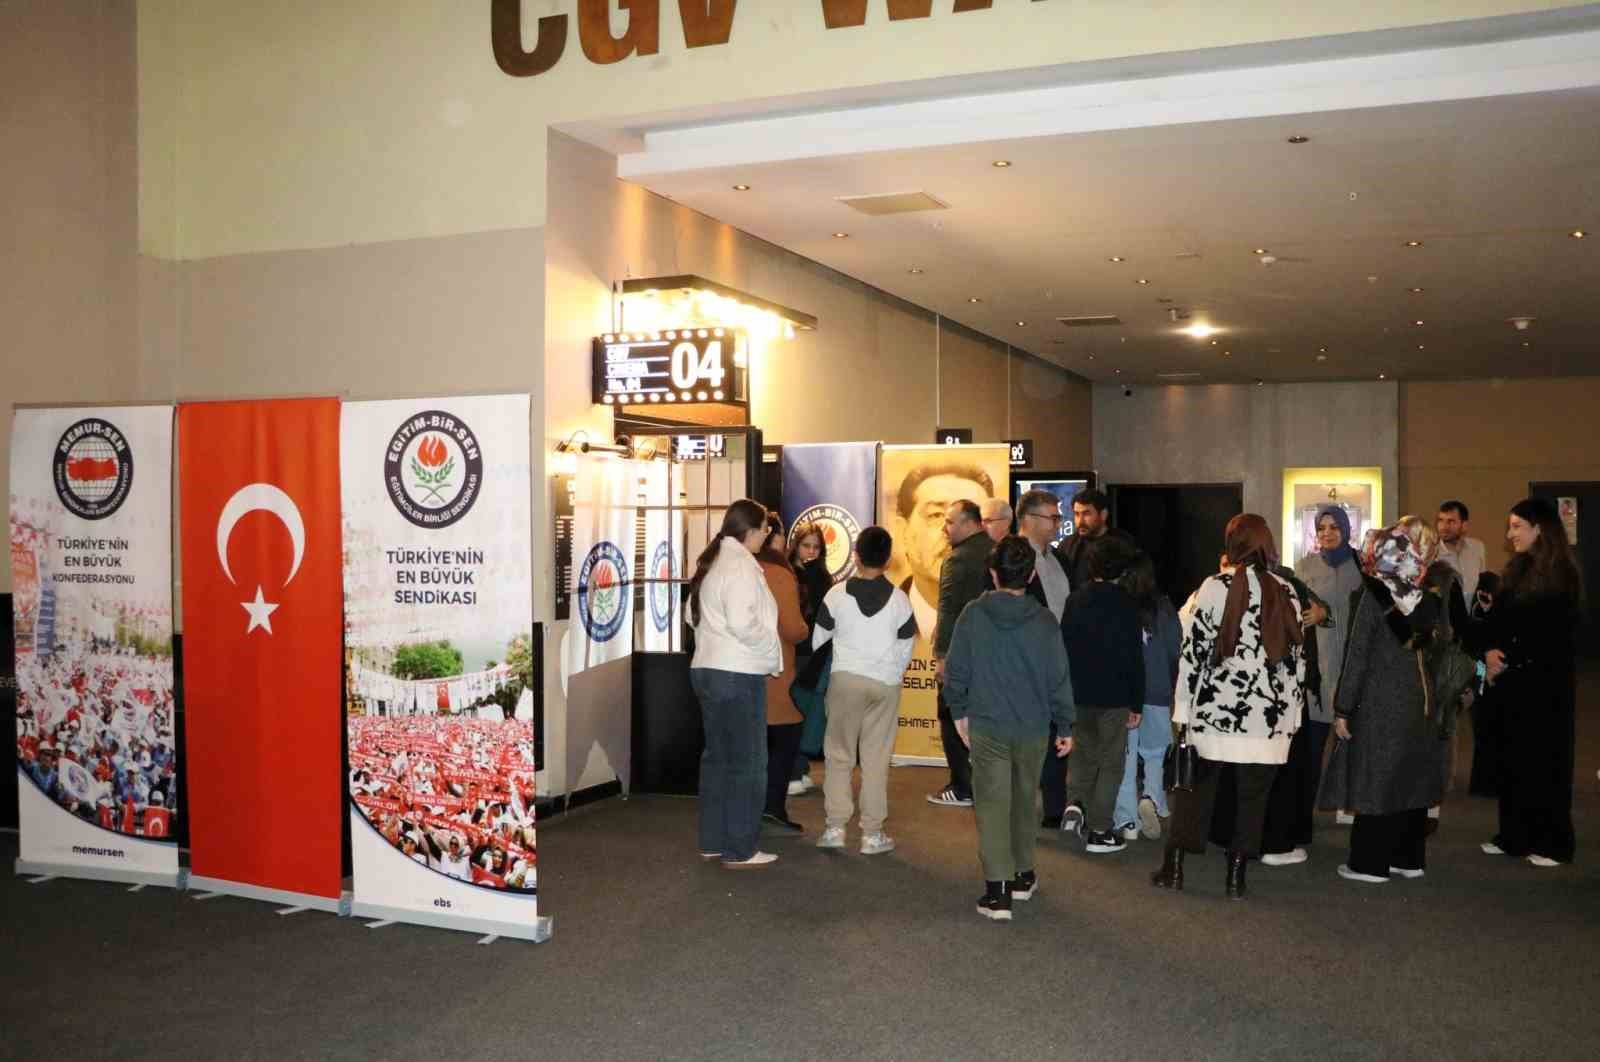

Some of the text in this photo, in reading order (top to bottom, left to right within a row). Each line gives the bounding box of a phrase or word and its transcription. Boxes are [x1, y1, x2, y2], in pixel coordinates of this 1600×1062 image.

[671, 341, 725, 389] 04
[1327, 488, 1337, 500] 4
[57, 536, 129, 550] TÜRKİYE'NİN
[64, 553, 122, 568] EN BÜYÜK
[386, 546, 484, 564] TÜRKİYE'NİN
[52, 572, 136, 585] KONFEDERASYONU
[396, 567, 474, 584] EN BÜYÜK
[72, 845, 125, 858] memursen
[433, 896, 452, 908] ebs
